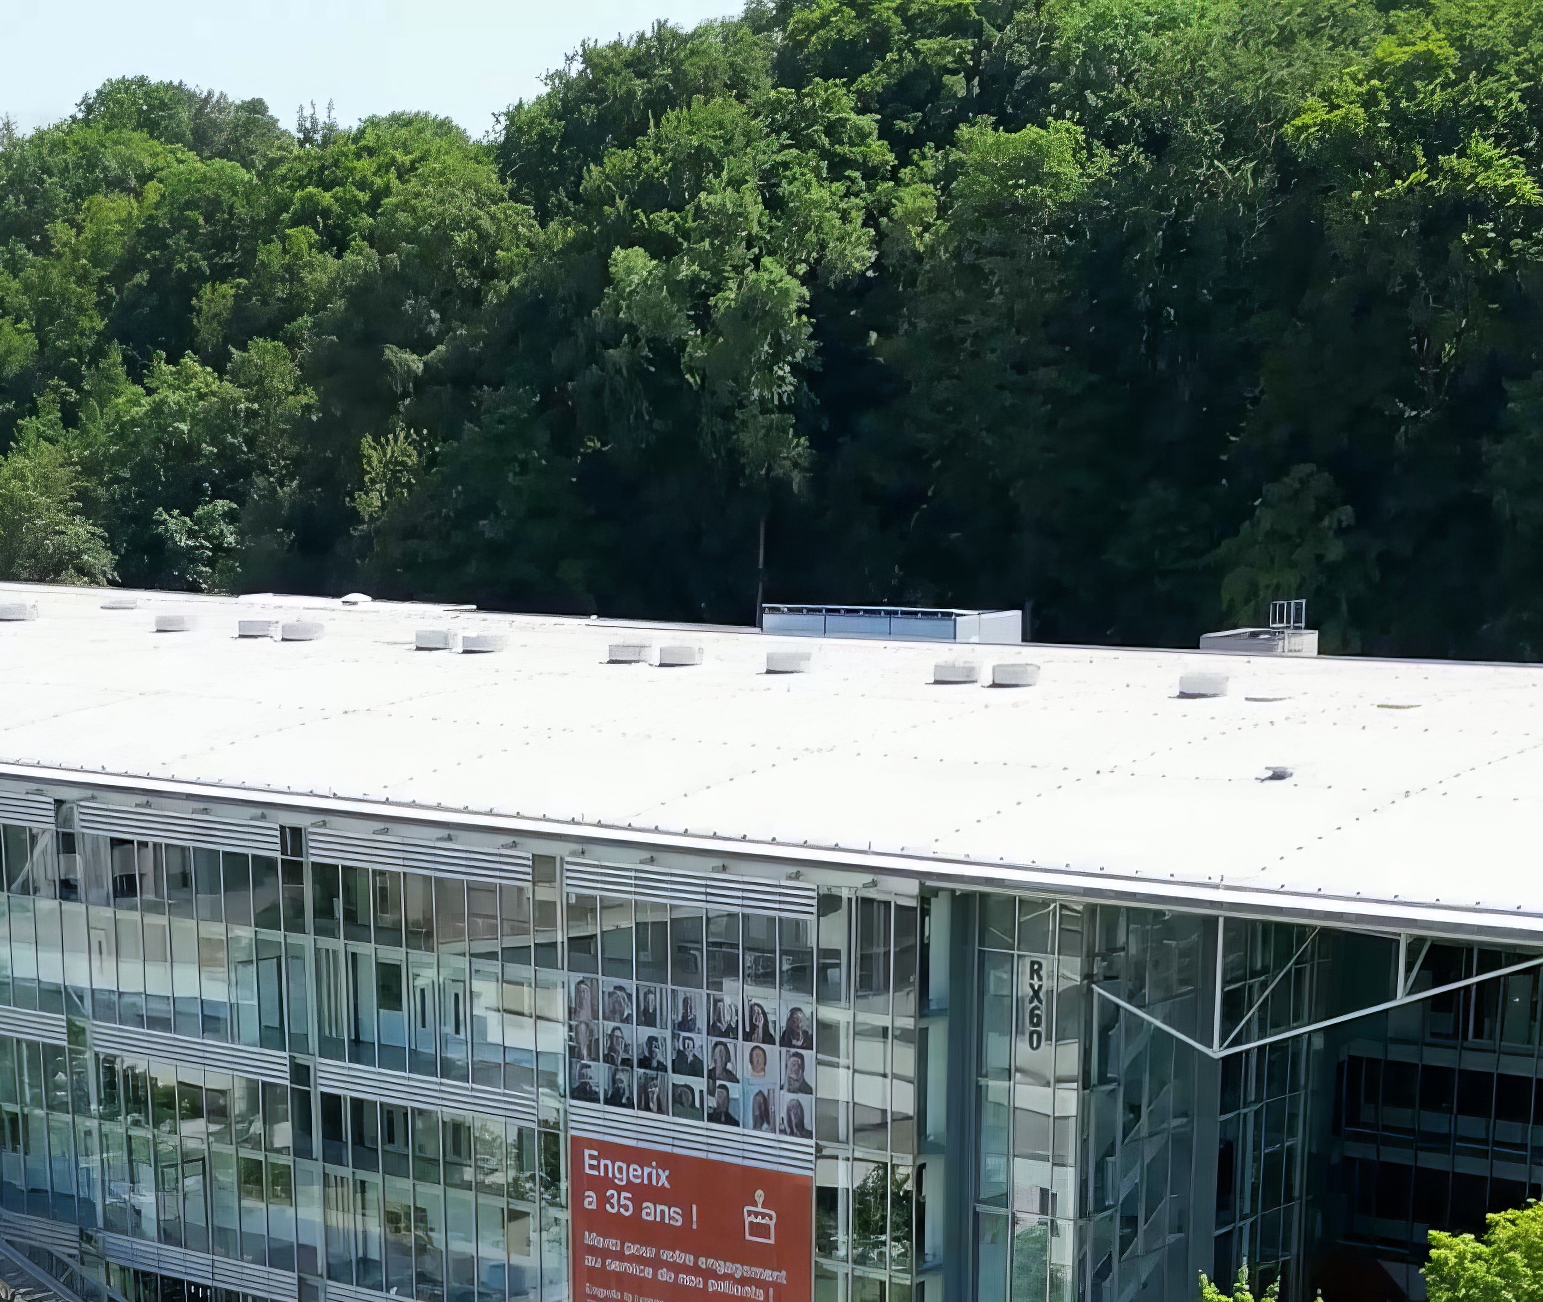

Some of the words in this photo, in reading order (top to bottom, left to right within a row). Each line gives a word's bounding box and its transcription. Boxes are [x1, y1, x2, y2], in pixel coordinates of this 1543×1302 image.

[1028, 960, 1043, 1051] RX60
[584, 1149, 670, 1188] Engerix
[584, 1190, 597, 1209] a
[606, 1189, 633, 1217] 35
[642, 1201, 682, 1226] ans
[691, 1204, 697, 1229] !
